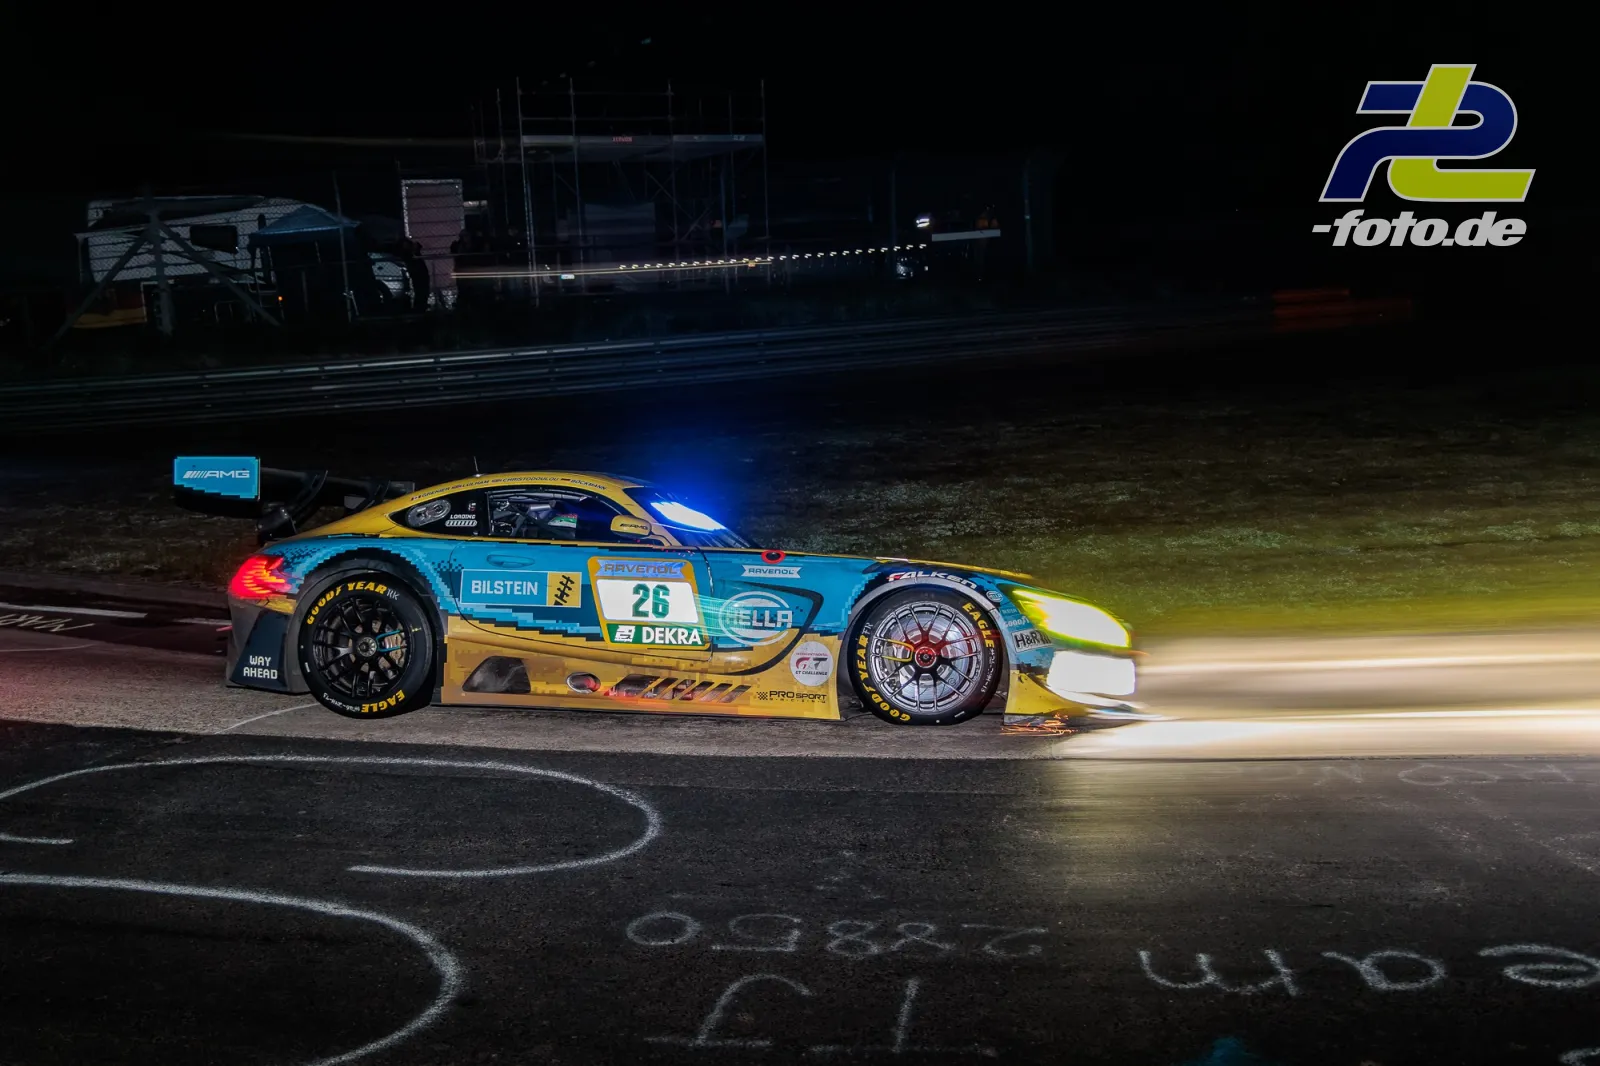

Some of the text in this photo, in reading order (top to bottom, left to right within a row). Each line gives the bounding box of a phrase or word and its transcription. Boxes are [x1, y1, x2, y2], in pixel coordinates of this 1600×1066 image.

[203, 470, 250, 479] AMG
[604, 563, 678, 575] RAVENOL
[748, 567, 794, 576] RAVENOL
[471, 580, 538, 596] BILSTEIN
[632, 583, 670, 619] 26
[962, 602, 995, 649] EAGLE
[642, 626, 703, 645] DEKRA
[249, 655, 272, 667] WAY
[243, 667, 279, 680] AHEAD
[361, 690, 406, 713] EAGLE
